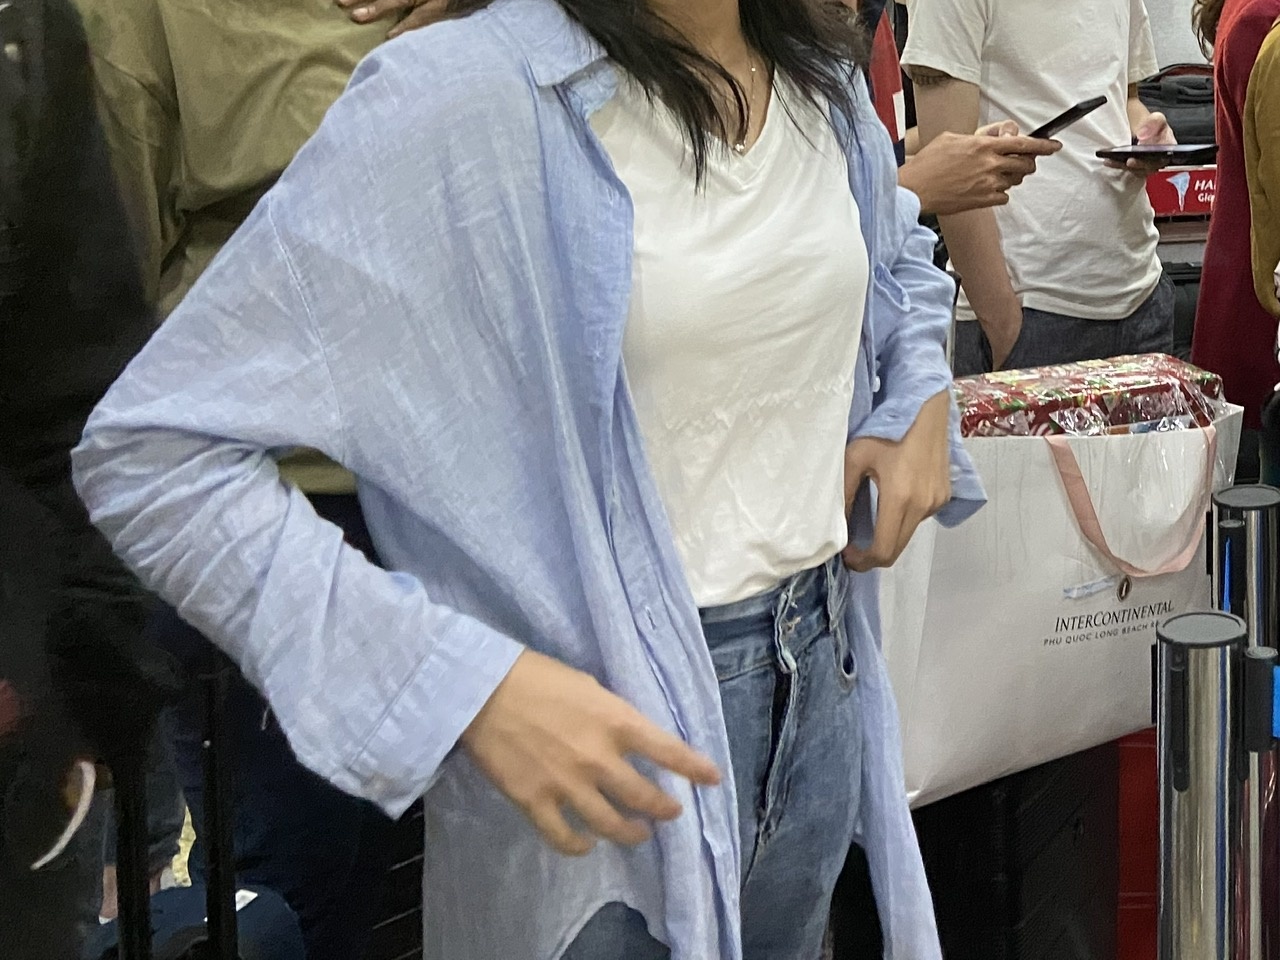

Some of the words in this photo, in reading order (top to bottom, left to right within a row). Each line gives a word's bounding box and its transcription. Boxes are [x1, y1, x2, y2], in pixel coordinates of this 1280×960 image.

[1194, 179, 1217, 191] HA
[1065, 633, 1092, 644] QUOC
[1095, 628, 1118, 639] LONG
[1121, 623, 1148, 635] BEACH
